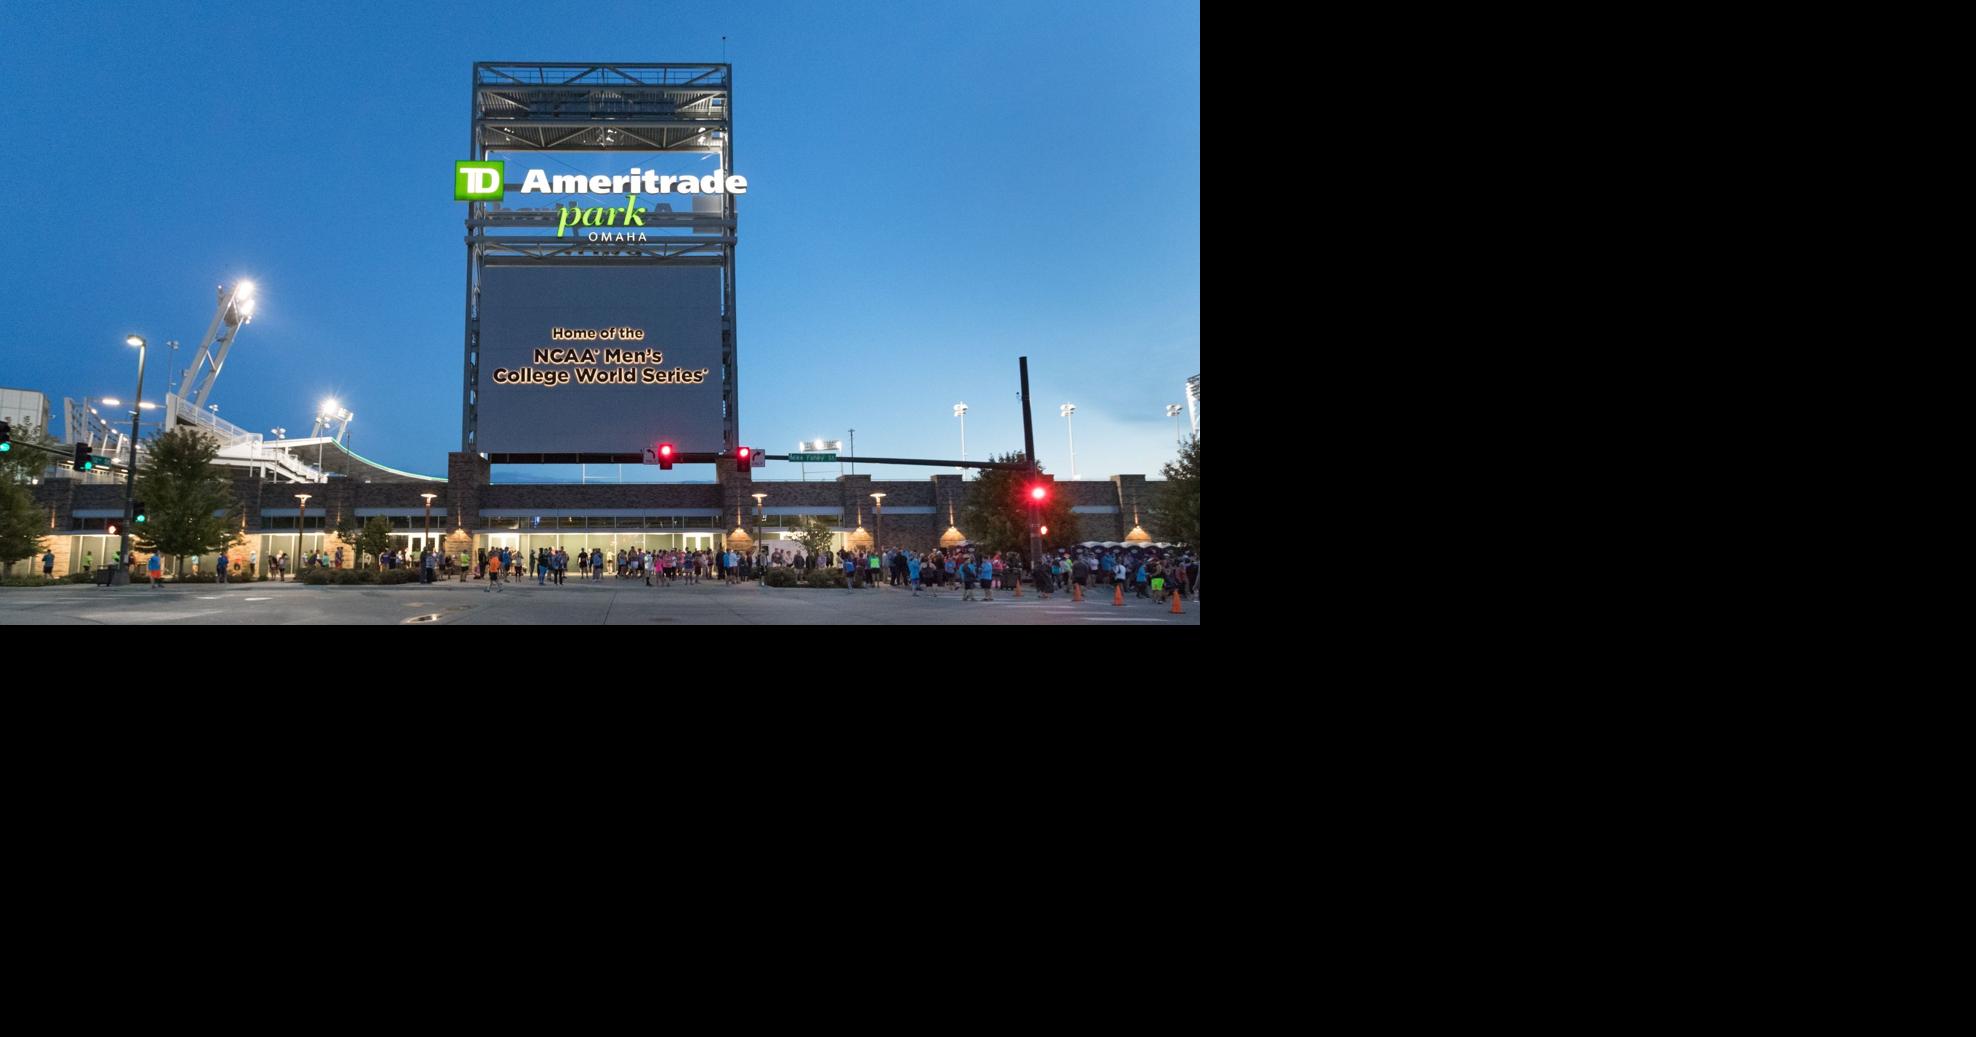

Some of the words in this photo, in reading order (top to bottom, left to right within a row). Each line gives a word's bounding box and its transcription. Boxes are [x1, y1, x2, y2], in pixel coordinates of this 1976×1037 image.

[460, 167, 500, 194] TD
[520, 167, 748, 194] Ameritrade
[556, 194, 648, 238] park
[588, 231, 647, 242] OMAHA
[552, 327, 596, 340] Home
[599, 327, 616, 340] of
[619, 327, 644, 340] the
[604, 348, 662, 365] Men's
[493, 367, 569, 387] College
[574, 367, 637, 384] World
